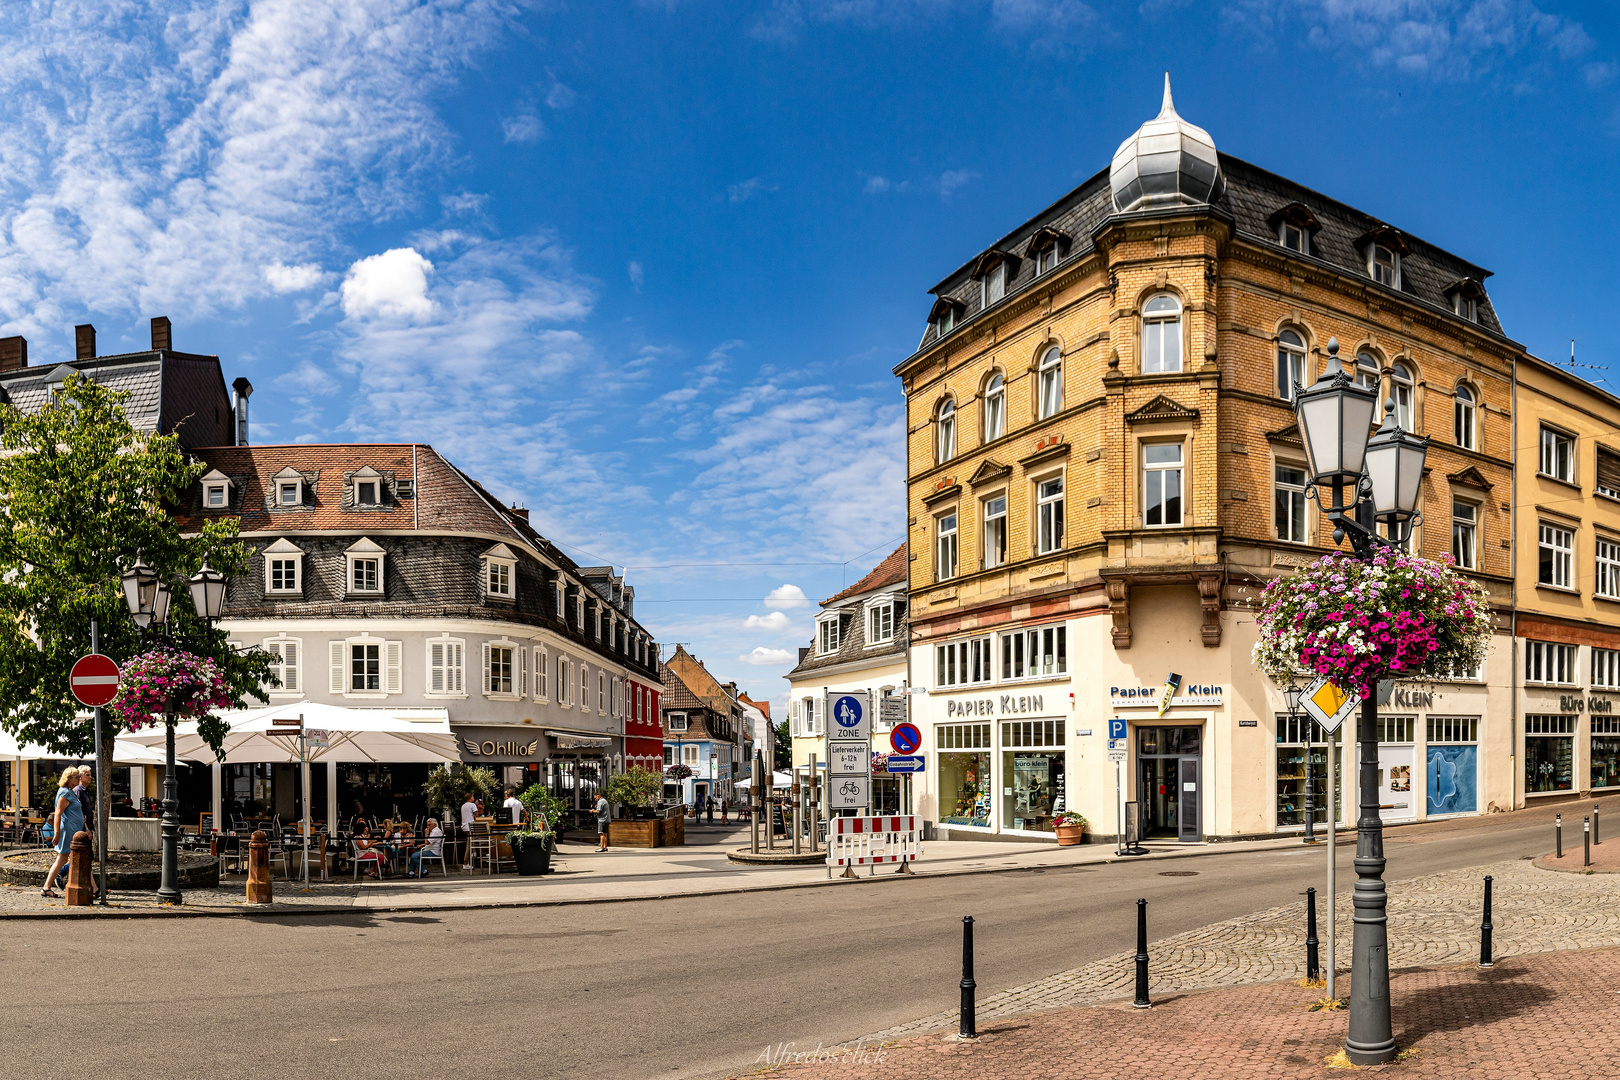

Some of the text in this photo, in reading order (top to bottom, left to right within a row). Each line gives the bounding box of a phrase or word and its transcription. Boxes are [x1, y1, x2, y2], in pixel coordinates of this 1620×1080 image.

[1110, 684, 1222, 698] Papier Klein
[948, 694, 1043, 717] PAPIER KLEIN
[1395, 689, 1433, 708] KLEIN
[1560, 695, 1612, 713] Büro Klein
[838, 729, 860, 738] ZONE
[1112, 721, 1123, 737] P
[832, 746, 865, 754] Lieferverkehr
[844, 763, 855, 771] frei
[844, 796, 856, 804] frei
